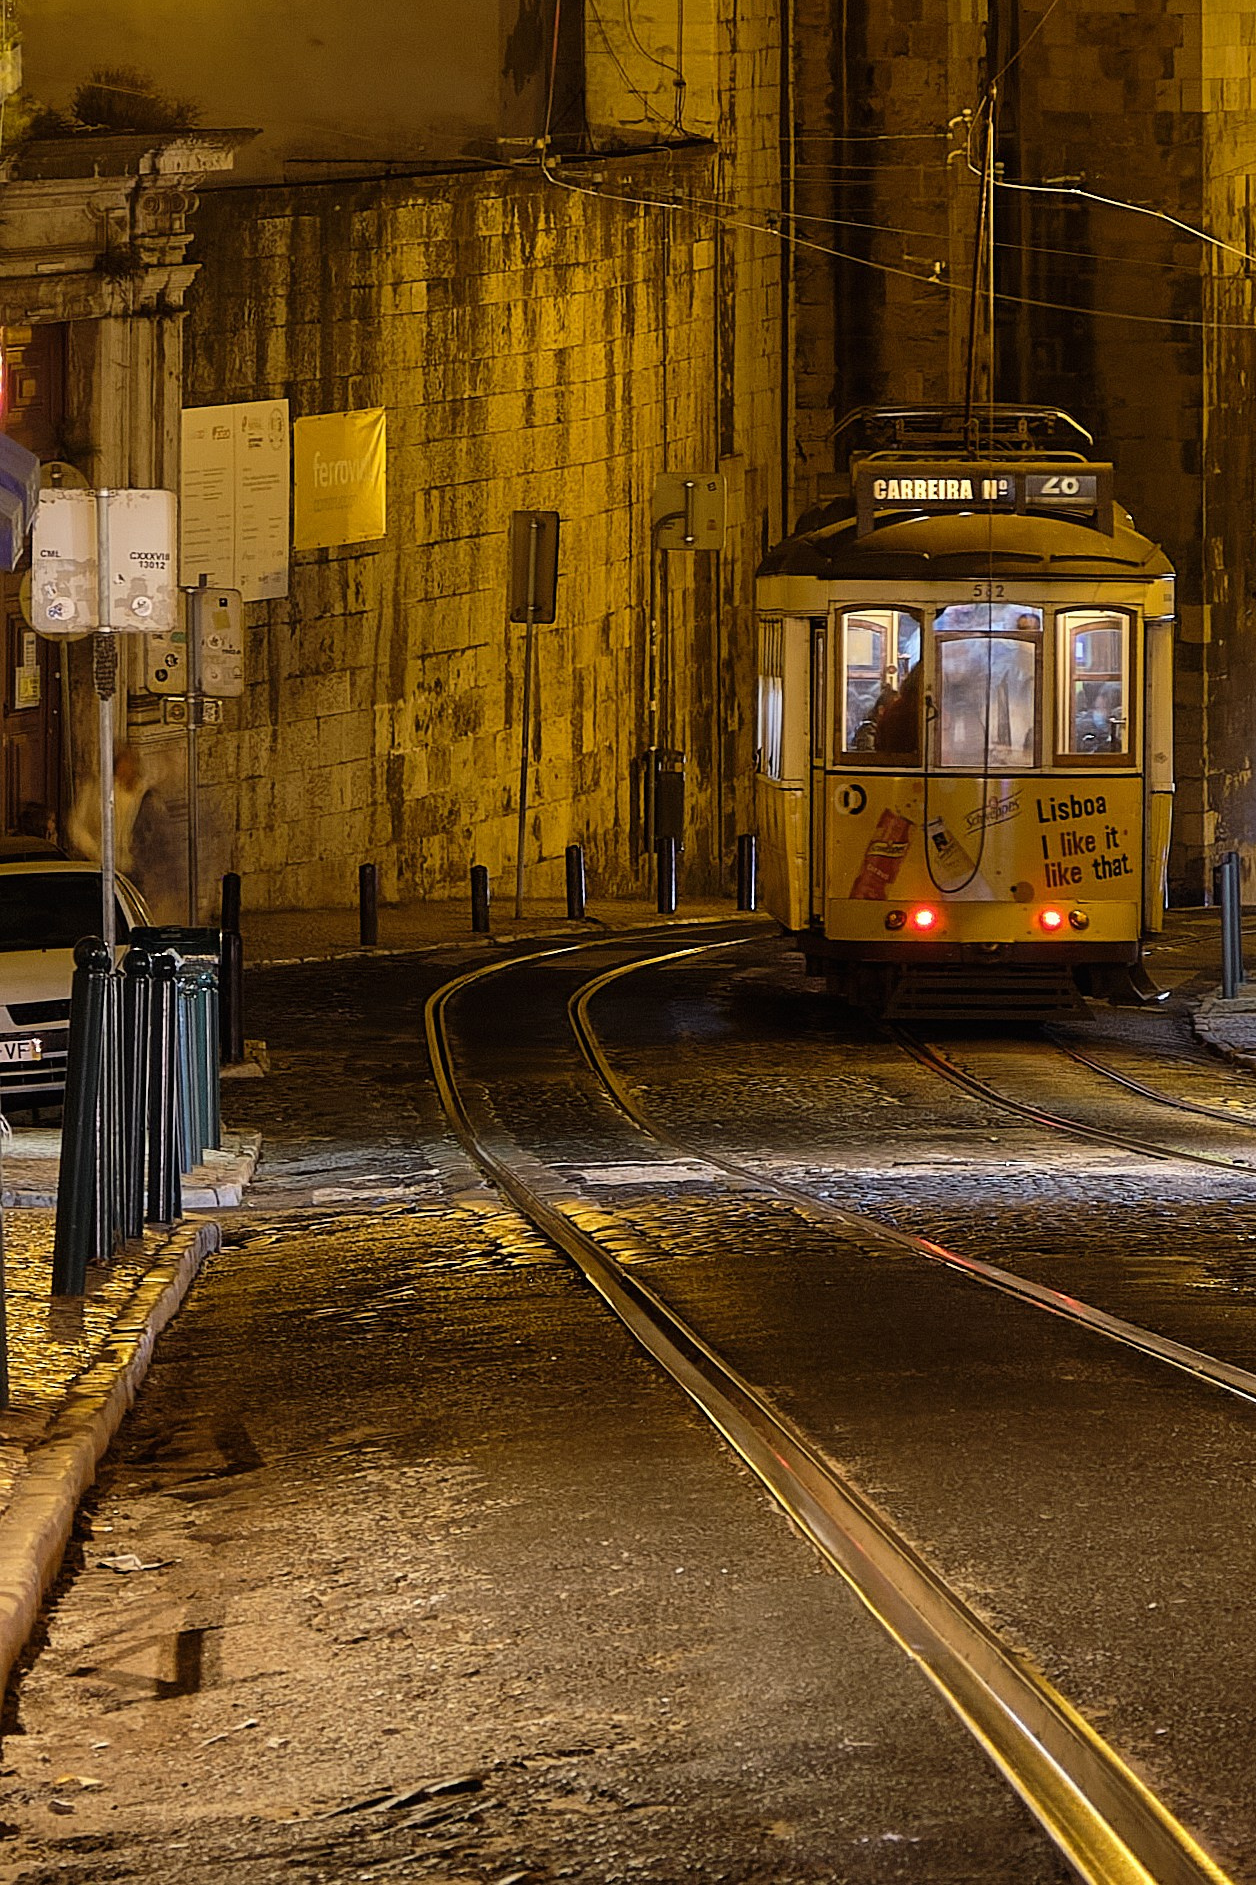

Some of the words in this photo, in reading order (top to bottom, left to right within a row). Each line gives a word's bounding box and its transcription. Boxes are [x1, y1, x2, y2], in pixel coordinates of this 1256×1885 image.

[873, 478, 974, 500] CARREIRA
[139, 561, 166, 570] 13012
[1036, 795, 1107, 823] Lisboa
[1041, 835, 1049, 860] I
[1060, 831, 1096, 857] like
[1105, 825, 1119, 848] it
[1044, 863, 1083, 889] like
[1092, 853, 1133, 881] that.
